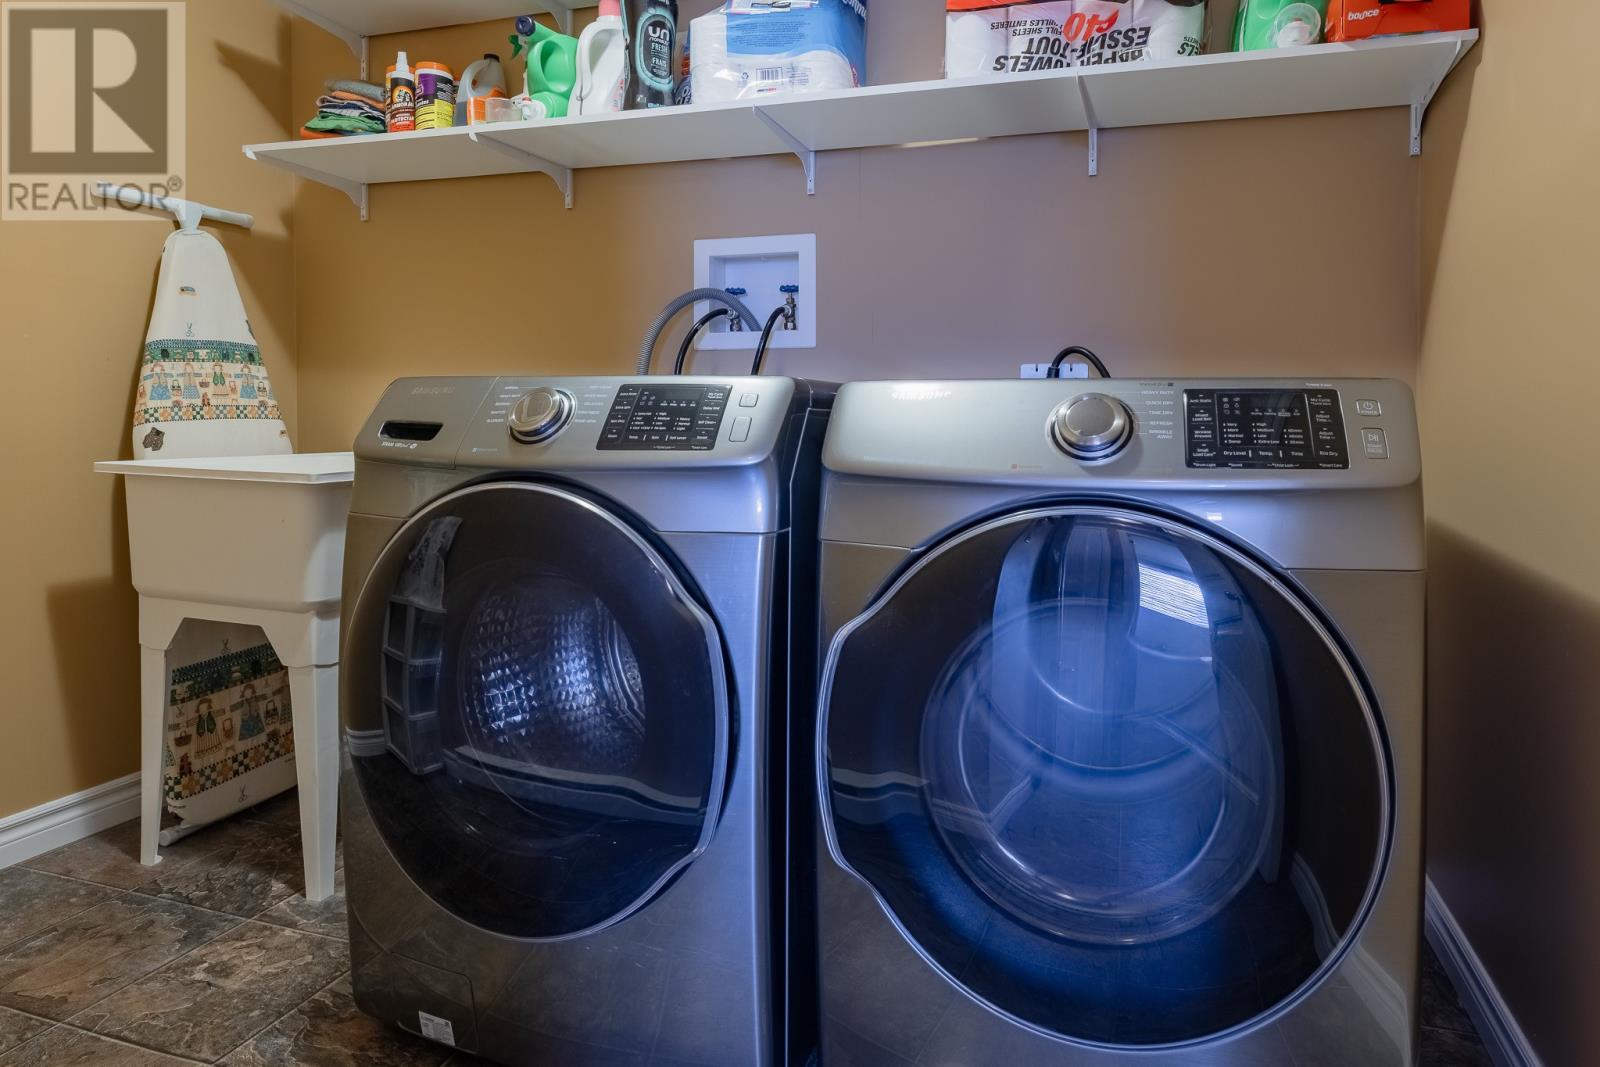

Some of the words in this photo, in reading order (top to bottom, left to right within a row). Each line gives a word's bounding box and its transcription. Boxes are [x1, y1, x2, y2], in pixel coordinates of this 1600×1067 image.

[1347, 9, 1380, 21] bounce
[990, 20, 1027, 30] ENTIÈRES
[1062, 10, 1120, 44] 40
[1012, 27, 1043, 37] SHEETS
